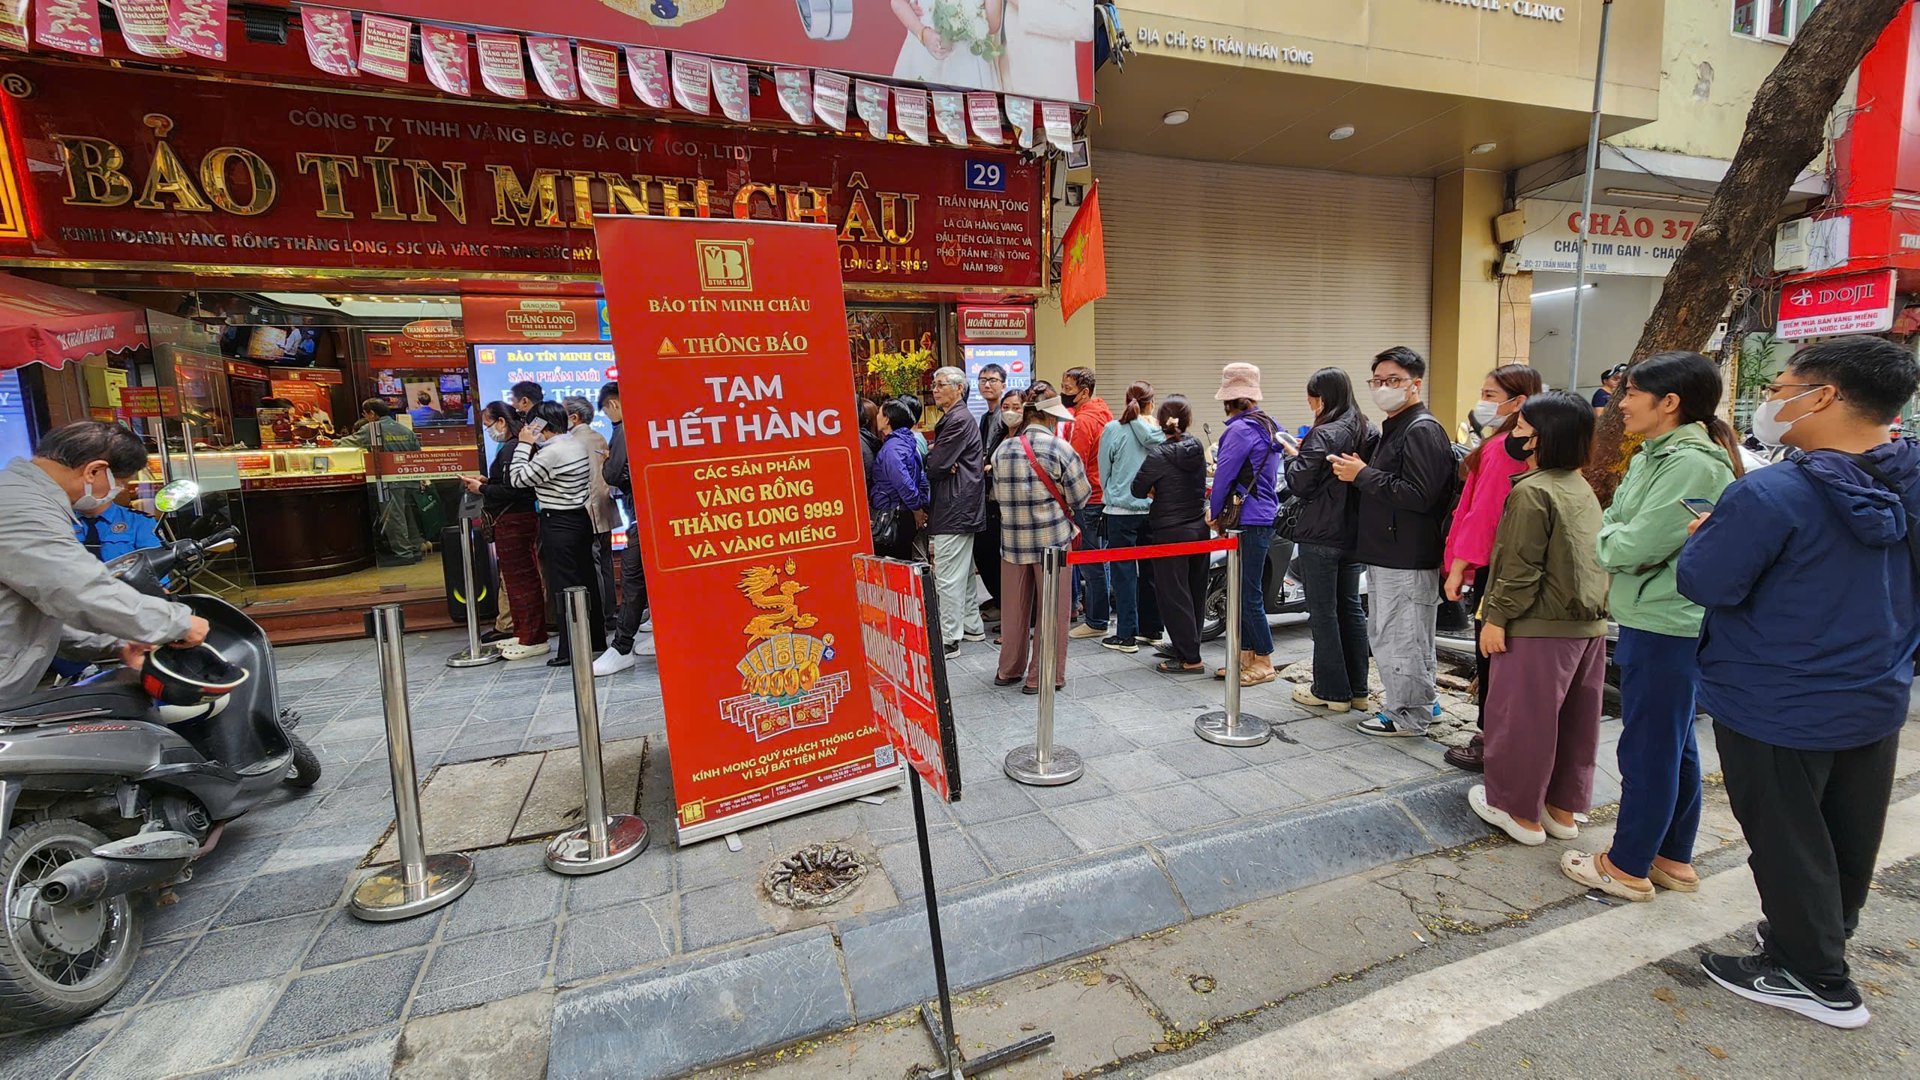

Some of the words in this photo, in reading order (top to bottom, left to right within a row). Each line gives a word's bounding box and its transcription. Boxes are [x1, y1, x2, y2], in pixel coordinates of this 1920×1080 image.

[1513, 1, 1566, 22] CLINIC
[1138, 27, 1159, 46] ĐỊA
[1192, 35, 1206, 50] 35
[1246, 43, 1278, 60] NHÂN
[1282, 45, 1313, 65] TÔNG
[288, 106, 357, 130] CÔNG
[363, 115, 394, 132] TY
[402, 119, 460, 138] TNHH
[468, 121, 526, 143] VÀNG
[533, 128, 575, 150] BẠC
[582, 130, 609, 150] ĐÁ
[615, 132, 655, 153] QUÝ
[713, 143, 752, 161] LTD)
[55, 113, 277, 216] BẢO
[296, 136, 468, 226] TÍN
[485, 165, 715, 229] MINH
[733, 171, 920, 245] CHÂU
[973, 163, 1001, 187] 29
[968, 196, 998, 210] NHÂN
[1000, 198, 1029, 212] TÔNG
[943, 217, 954, 228] LÀ
[956, 217, 973, 230] CỬA
[974, 219, 1000, 231] HÀNG
[1567, 209, 1655, 239] CHÁO
[1661, 219, 1697, 241] 37
[111, 228, 174, 246] DOANH
[178, 229, 227, 247] VÀNG
[232, 231, 280, 249] RỒNG
[285, 234, 340, 251] THĂNG
[343, 239, 393, 256] LONG,
[396, 242, 422, 255] SJC
[427, 240, 447, 256] VÀ
[451, 241, 490, 258] VÀNG
[543, 243, 569, 261] SỨC
[572, 244, 593, 261] MỸ
[977, 234, 994, 246] CỦA
[996, 236, 1020, 247] BTMC
[1554, 240, 1587, 254] CHÁ
[1592, 242, 1613, 255] TIM
[1617, 244, 1642, 257] GAN
[1652, 245, 1682, 260] CHÁO
[844, 258, 874, 270] LONG
[1007, 249, 1030, 261] TÔNG
[985, 263, 1004, 274] 1989
[649, 296, 685, 313] BẢO
[688, 296, 717, 313] TÍN
[721, 299, 765, 313] MINH
[768, 296, 810, 313] CHÂU
[1818, 283, 1876, 306] DOJI
[507, 313, 544, 324] THĂNG
[546, 315, 574, 325] LONG
[967, 317, 993, 328] HOÀNG
[993, 318, 1008, 328] KIM
[1009, 317, 1025, 328] BẢO
[1801, 319, 1816, 327] MUA
[1833, 314, 1853, 323] VÀNG
[1855, 319, 1876, 329] PHÉP
[683, 332, 762, 355] THÔNG
[765, 330, 808, 352] BÁO
[507, 349, 534, 362] BẢO
[536, 349, 558, 362] TÍN
[560, 351, 592, 362] MINH
[508, 367, 535, 383] SẢN
[536, 366, 575, 383] PHẨM
[576, 368, 600, 382] MỚI
[704, 374, 784, 408] TẠM
[648, 407, 727, 449] HẾT
[735, 406, 842, 443] HÀNG
[437, 464, 463, 472] 19:00
[694, 464, 728, 481] CÁC
[731, 459, 763, 478] SẢN
[766, 456, 811, 474] PHẨM
[696, 484, 755, 508] VÀNG
[759, 475, 814, 499] RỒNG
[669, 510, 743, 537] THĂNG
[747, 505, 799, 528] LONG
[803, 499, 844, 520] 999.9
[688, 540, 718, 559] VÀ
[720, 534, 775, 554] VÀNG
[778, 524, 837, 547] MIẾNG
[909, 648, 932, 703] XE
[692, 767, 721, 783] KÍNH
[723, 758, 757, 774] MONG
[759, 749, 781, 766] QUÝ
[782, 740, 819, 758] KHÁCH
[820, 731, 855, 749] THÔNG
[856, 725, 878, 740] CẢM
[741, 769, 754, 781] VÌ
[755, 765, 770, 778] SỰ
[771, 758, 792, 772] BẤT
[793, 753, 816, 767] TIỆN
[817, 746, 839, 760] NÀY
